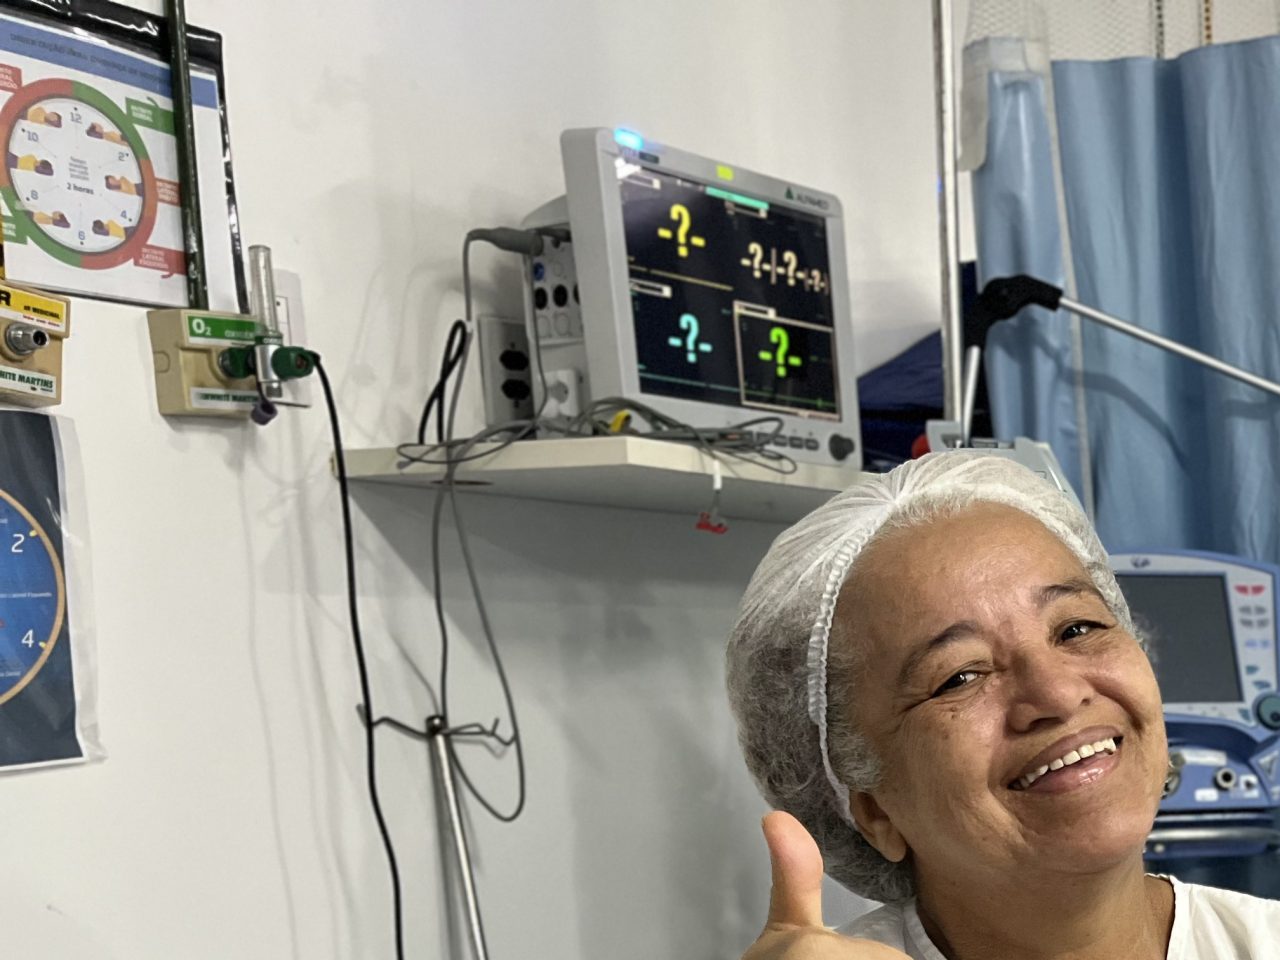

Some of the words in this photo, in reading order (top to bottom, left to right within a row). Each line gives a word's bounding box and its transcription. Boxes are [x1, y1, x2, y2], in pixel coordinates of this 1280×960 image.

[70, 112, 82, 124] 12
[27, 130, 39, 142] 10
[18, 373, 53, 389] MARTINS
[11, 534, 25, 553] 2
[21, 629, 34, 648] 4
